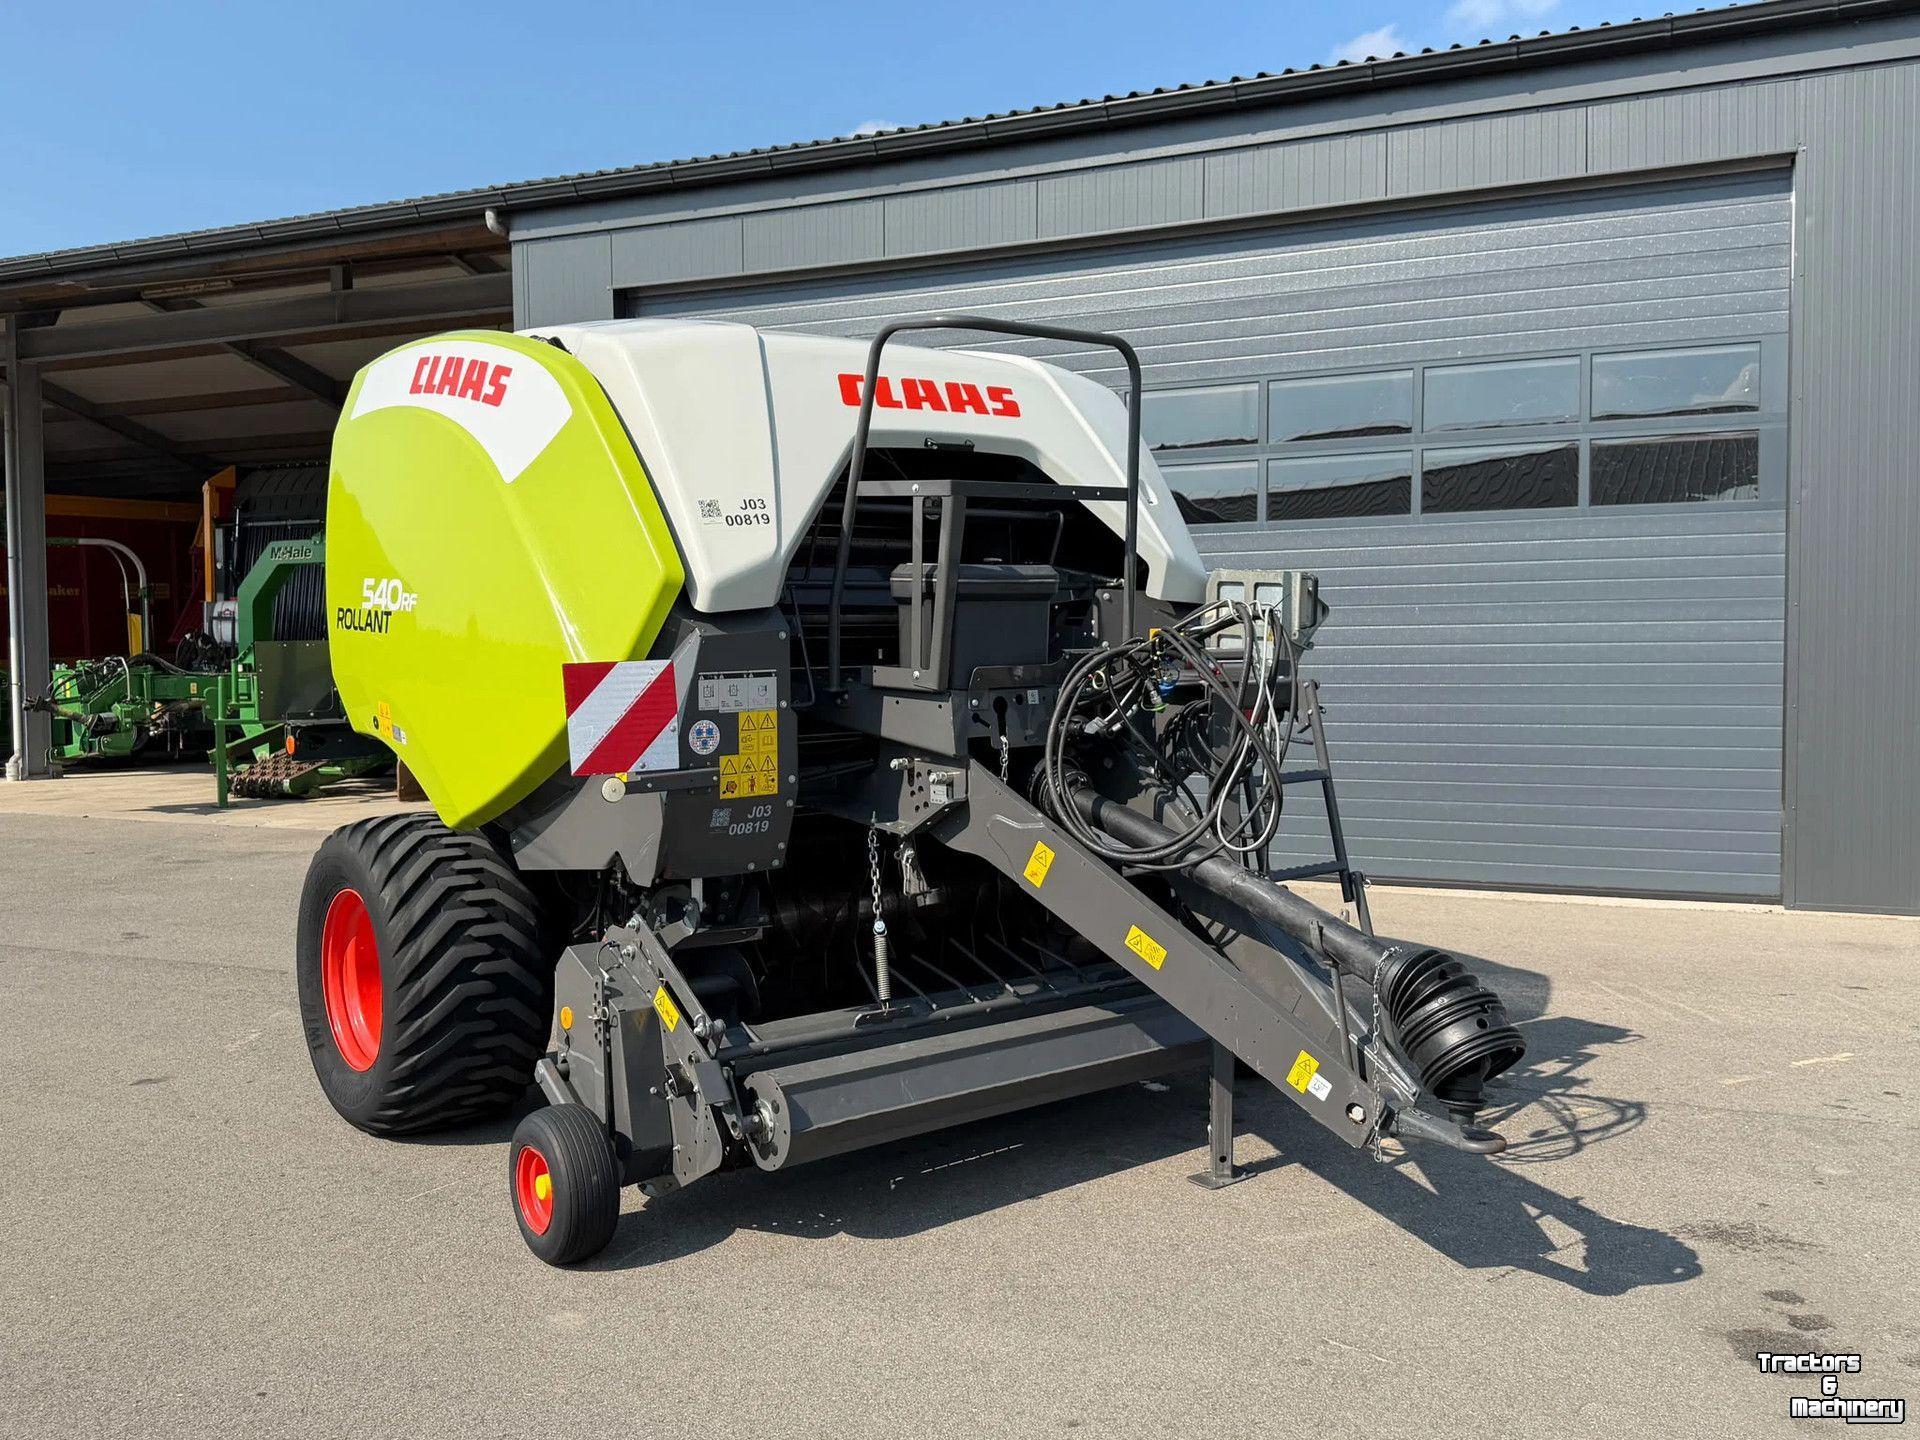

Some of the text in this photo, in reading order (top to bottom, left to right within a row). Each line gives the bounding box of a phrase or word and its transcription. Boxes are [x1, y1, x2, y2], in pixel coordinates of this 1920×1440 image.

[409, 355, 513, 408] CLAAS
[837, 373, 1021, 418] CLAAS
[739, 498, 766, 511] J03
[725, 513, 770, 526] 00819
[336, 607, 392, 634] ROLLANT
[747, 805, 772, 819] J03
[728, 820, 770, 836] 00819
